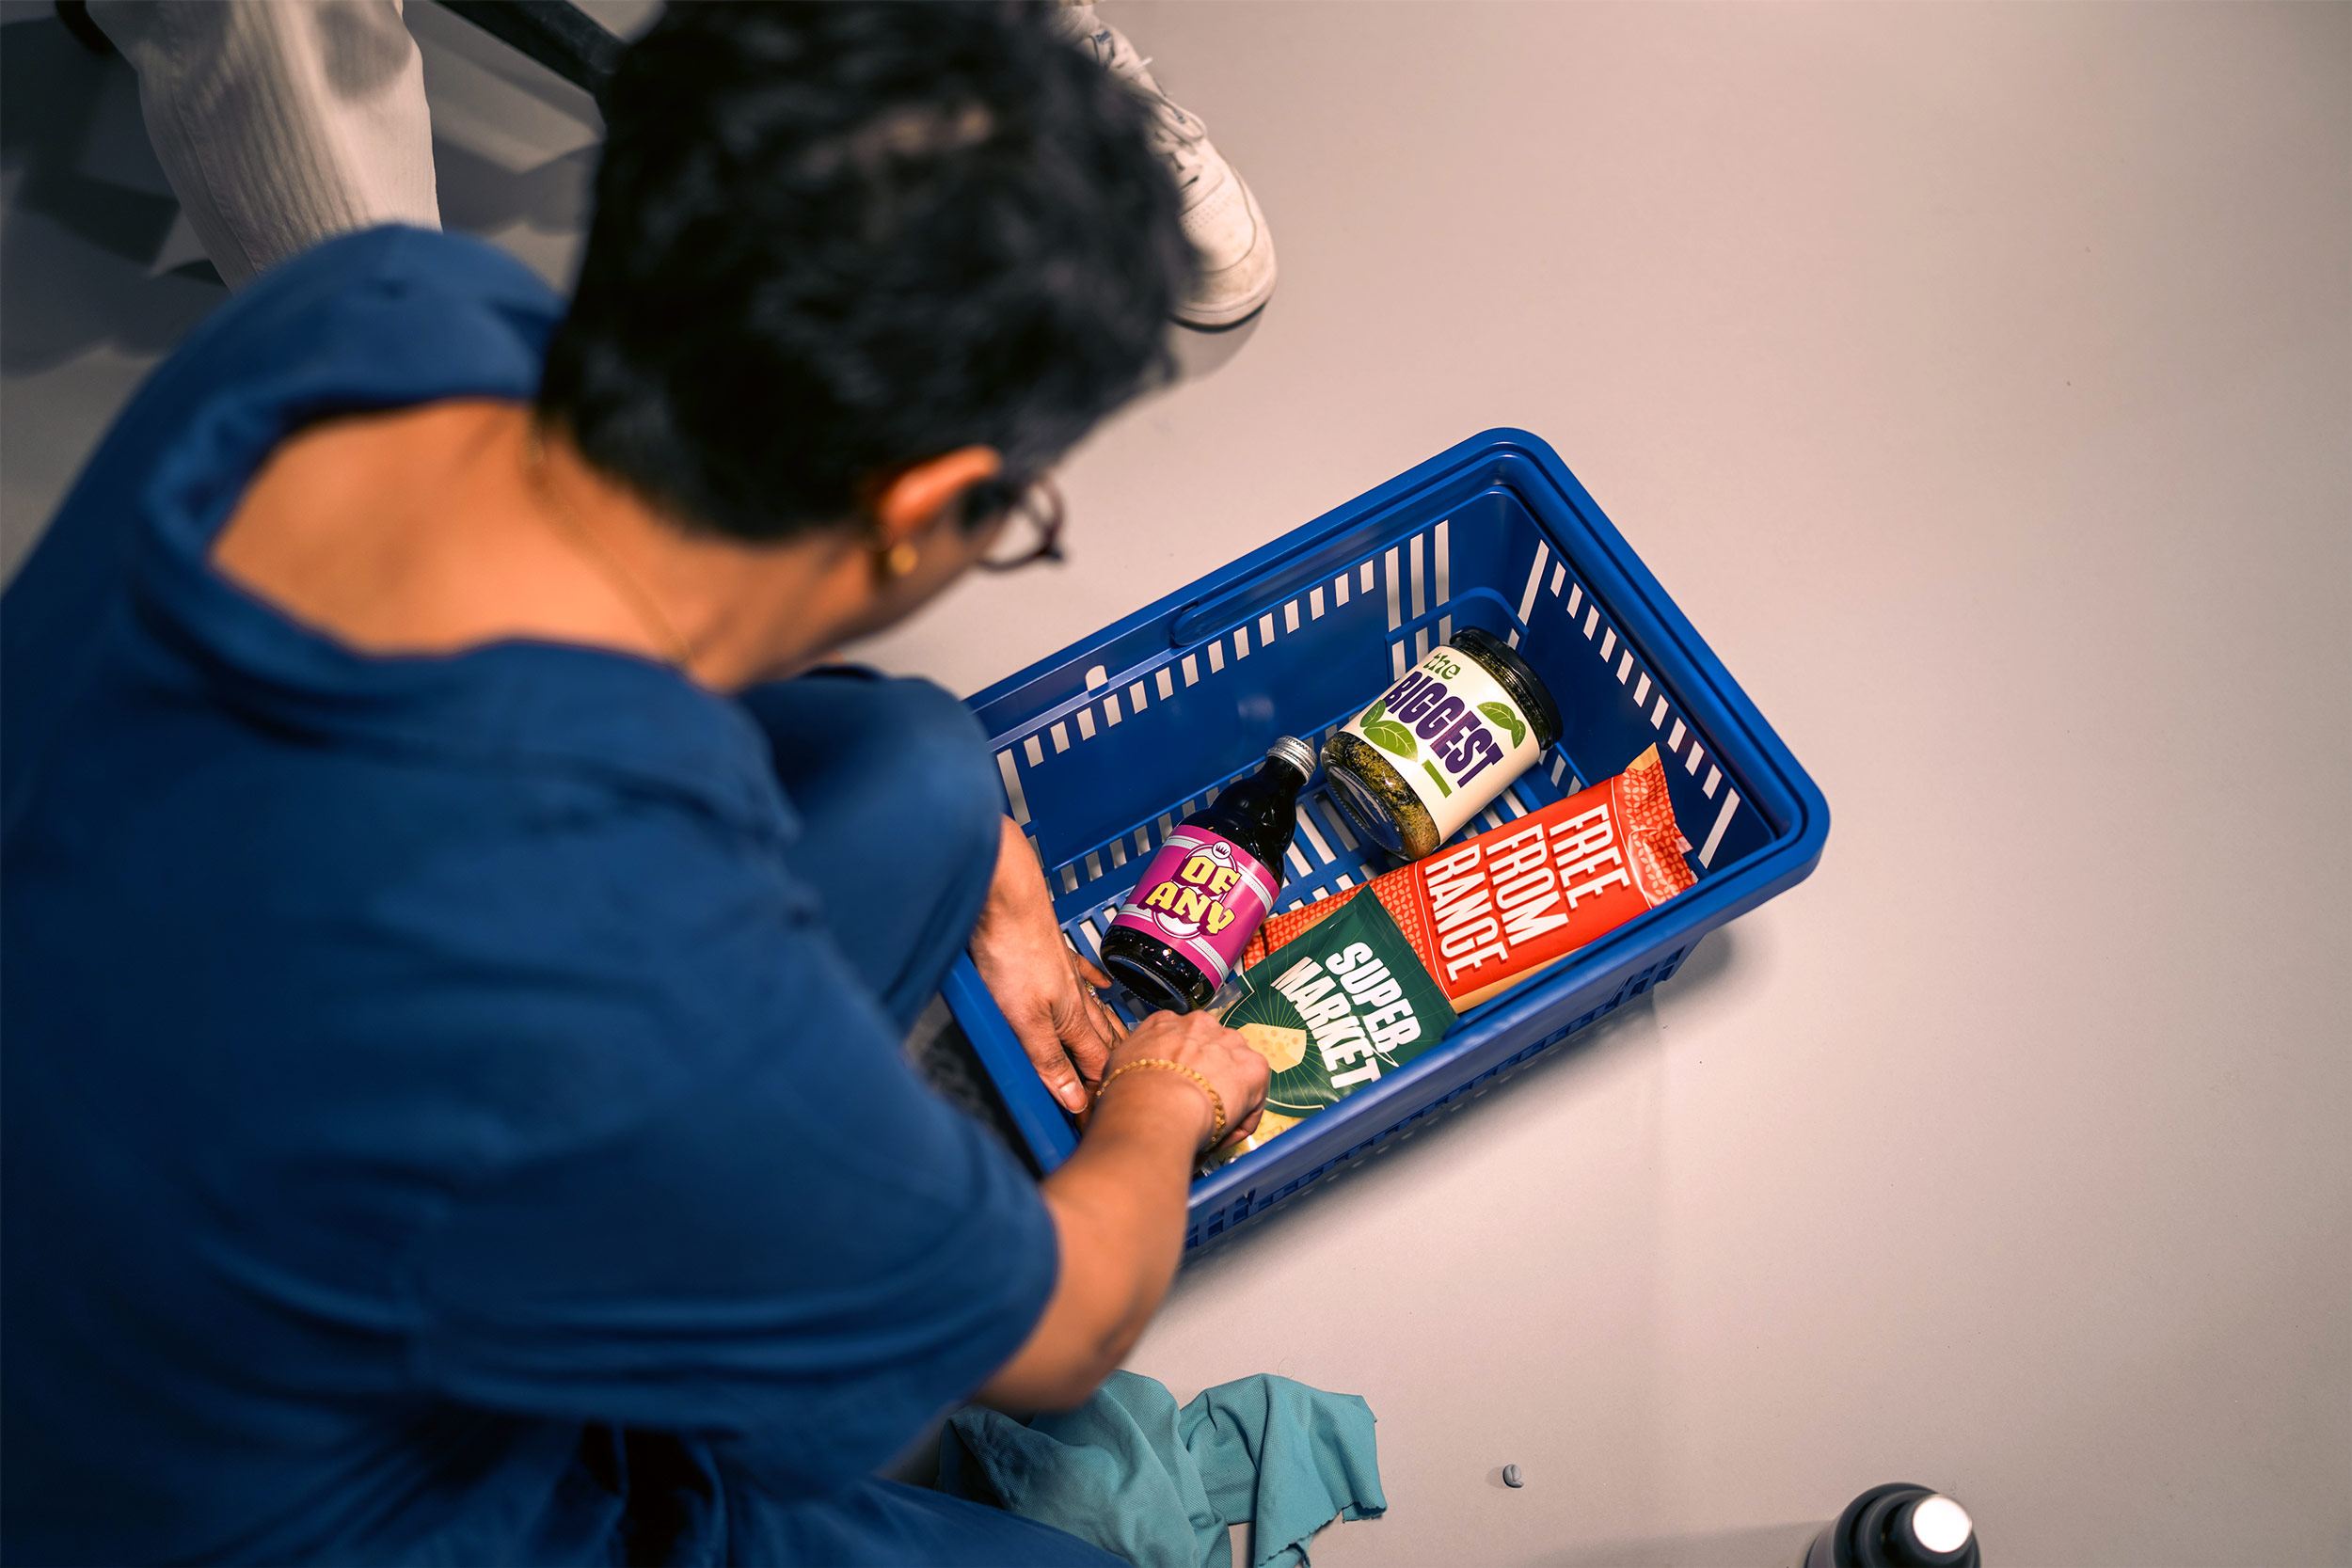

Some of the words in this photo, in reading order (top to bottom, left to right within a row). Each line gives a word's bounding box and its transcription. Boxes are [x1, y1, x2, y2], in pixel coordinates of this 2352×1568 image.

[1422, 652, 1461, 680] the
[1382, 671, 1504, 788] BIGGEST
[1144, 880, 1236, 935] ANY
[1179, 855, 1242, 895] OF
[1486, 823, 1569, 946] FROM
[1549, 803, 1631, 910] FREE
[1424, 844, 1509, 982] RANGE
[1270, 956, 1382, 1089] MARKET
[1325, 942, 1422, 1053] SUPER
